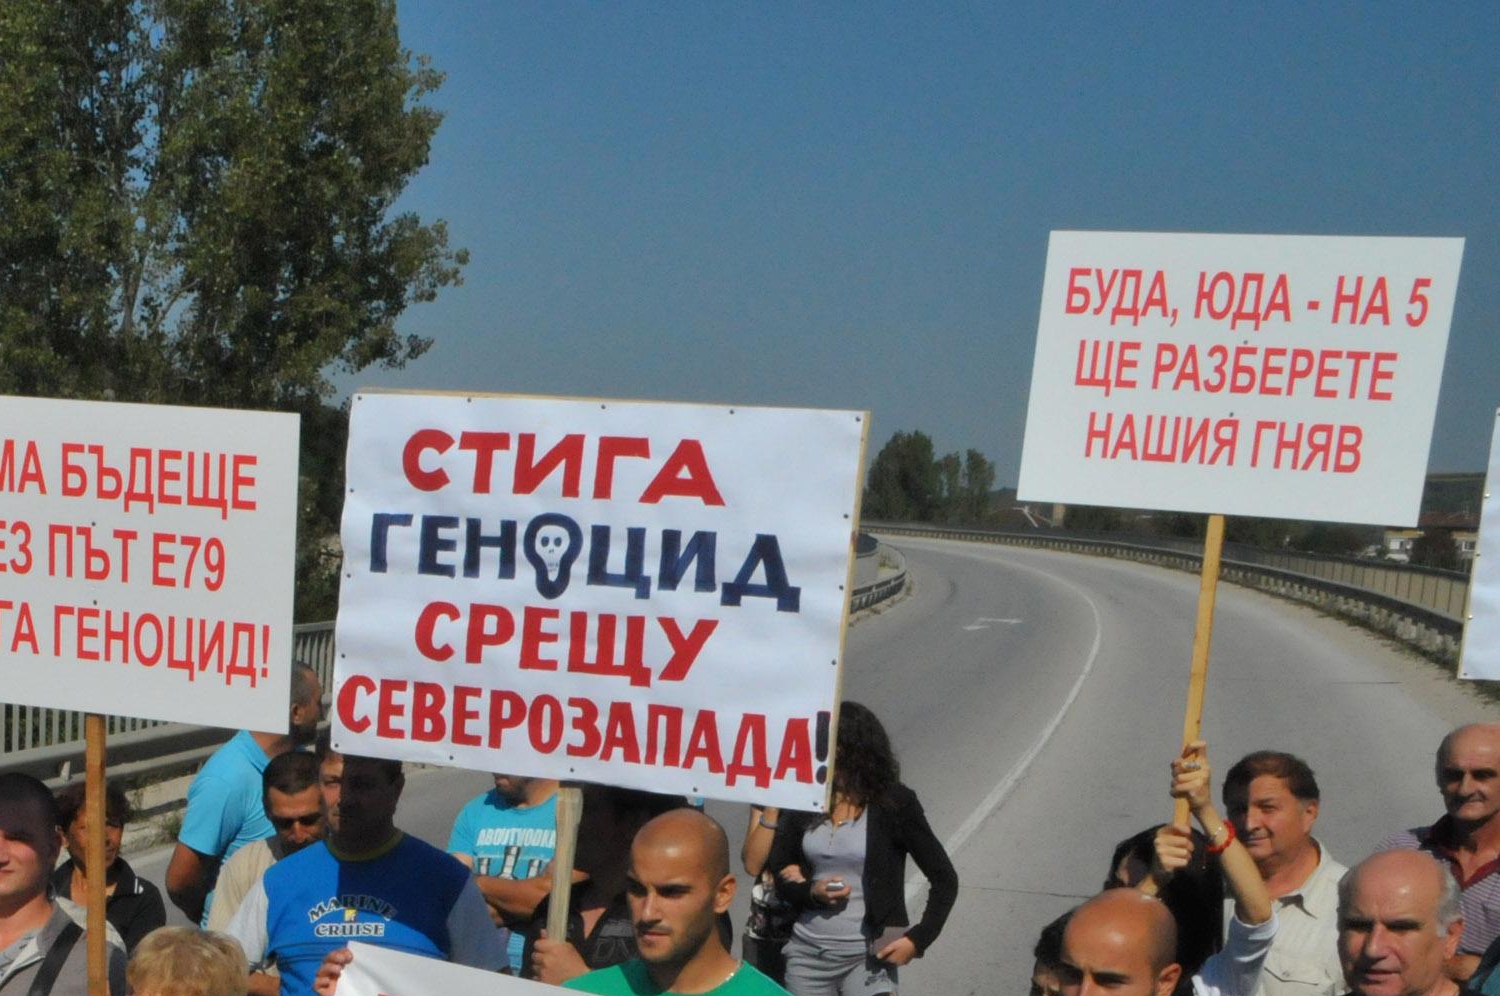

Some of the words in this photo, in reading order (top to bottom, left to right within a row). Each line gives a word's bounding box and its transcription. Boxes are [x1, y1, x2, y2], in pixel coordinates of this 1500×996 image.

[1064, 267, 1179, 328] БУДА,
[1194, 271, 1292, 331] ЮДА
[1331, 275, 1392, 326] НА
[1405, 277, 1433, 328] 5
[1074, 339, 1142, 397] ЩЕ
[1151, 343, 1399, 401] РАЗБЕРЕТЕ
[60, 442, 258, 519] БЪДЕЩЕ
[402, 428, 726, 507] СТИГА
[1084, 411, 1241, 466] НАШИЯ
[1251, 420, 1364, 474] ГНЯВ
[48, 523, 139, 584] ПЪТ
[151, 531, 227, 593] Е79
[369, 512, 801, 613] ГЕНОЦИД
[53, 604, 271, 688] ГЕНОЦИД!
[414, 601, 719, 688] СРЕЩУ
[336, 674, 831, 789] СЕВЕРОЗАПАДА!
[314, 921, 386, 938] CRUISE
